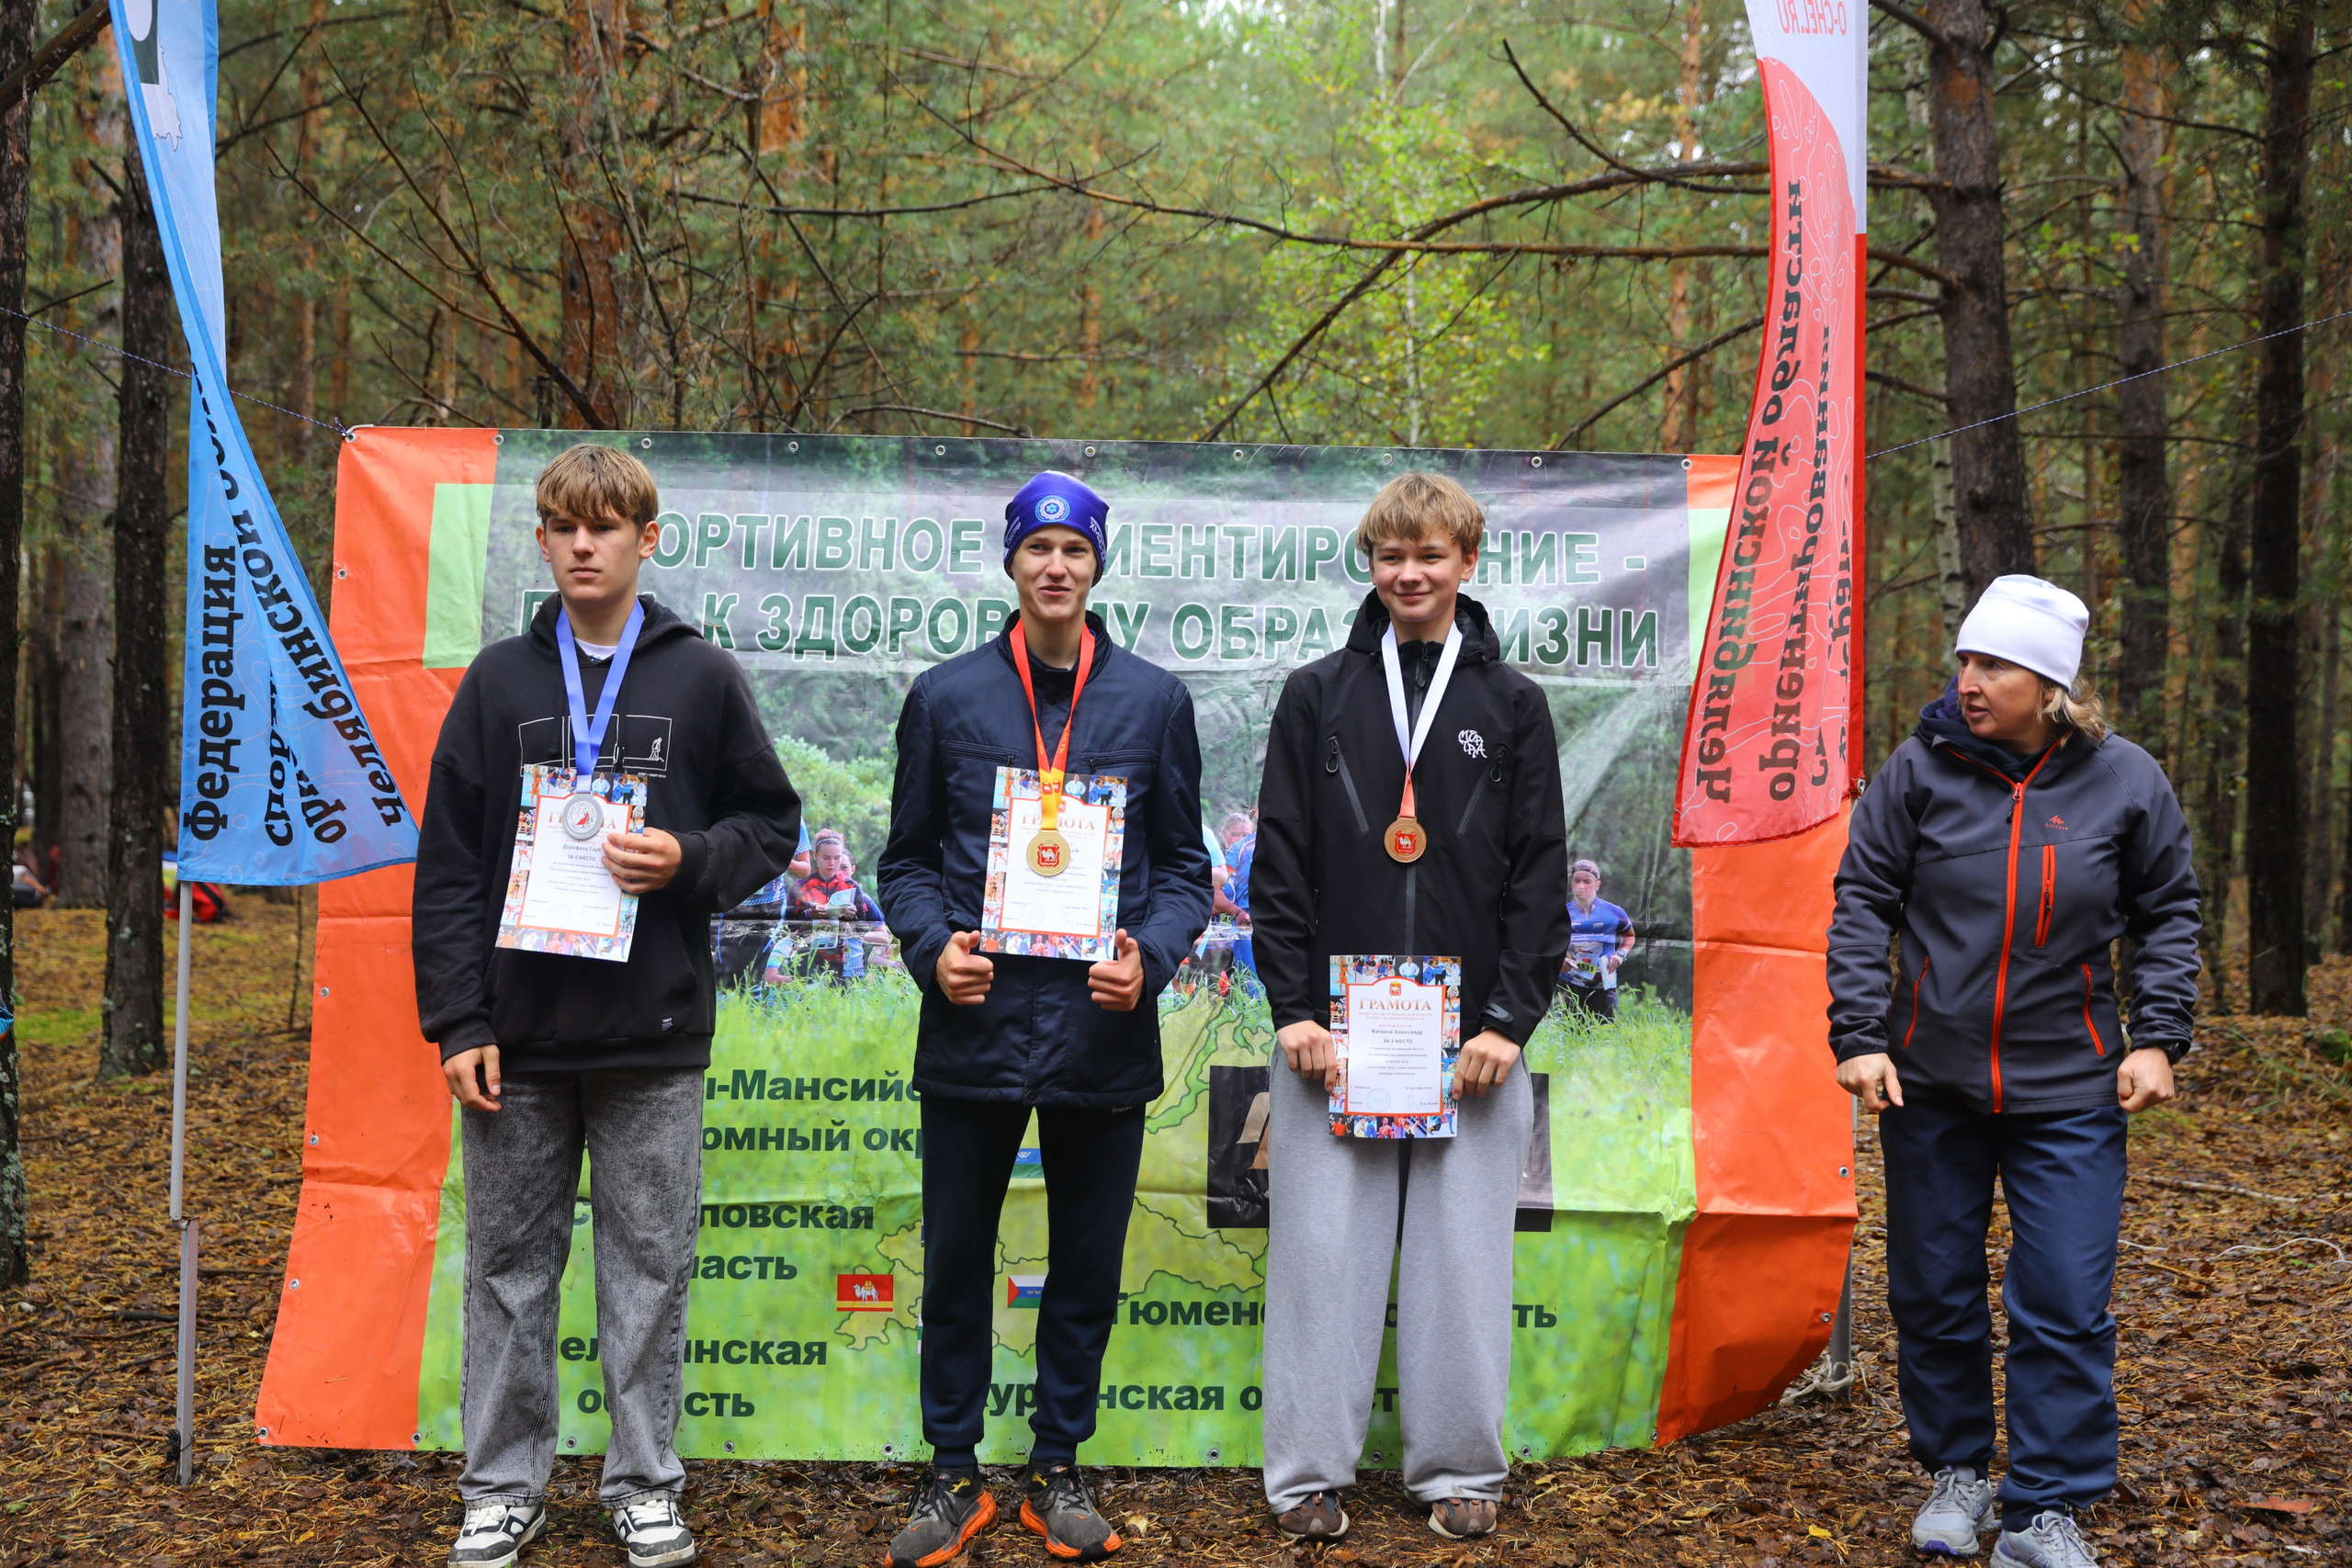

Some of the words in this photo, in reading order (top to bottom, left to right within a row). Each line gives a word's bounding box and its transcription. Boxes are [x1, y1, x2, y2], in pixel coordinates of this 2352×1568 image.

[650, 512, 984, 575] ОРТИВНОЕ
[1494, 606, 1658, 668] ИЗНИ
[184, 544, 245, 840] Федерация
[1359, 998, 1432, 1010] ГРАМОТА
[702, 1120, 850, 1151] омный
